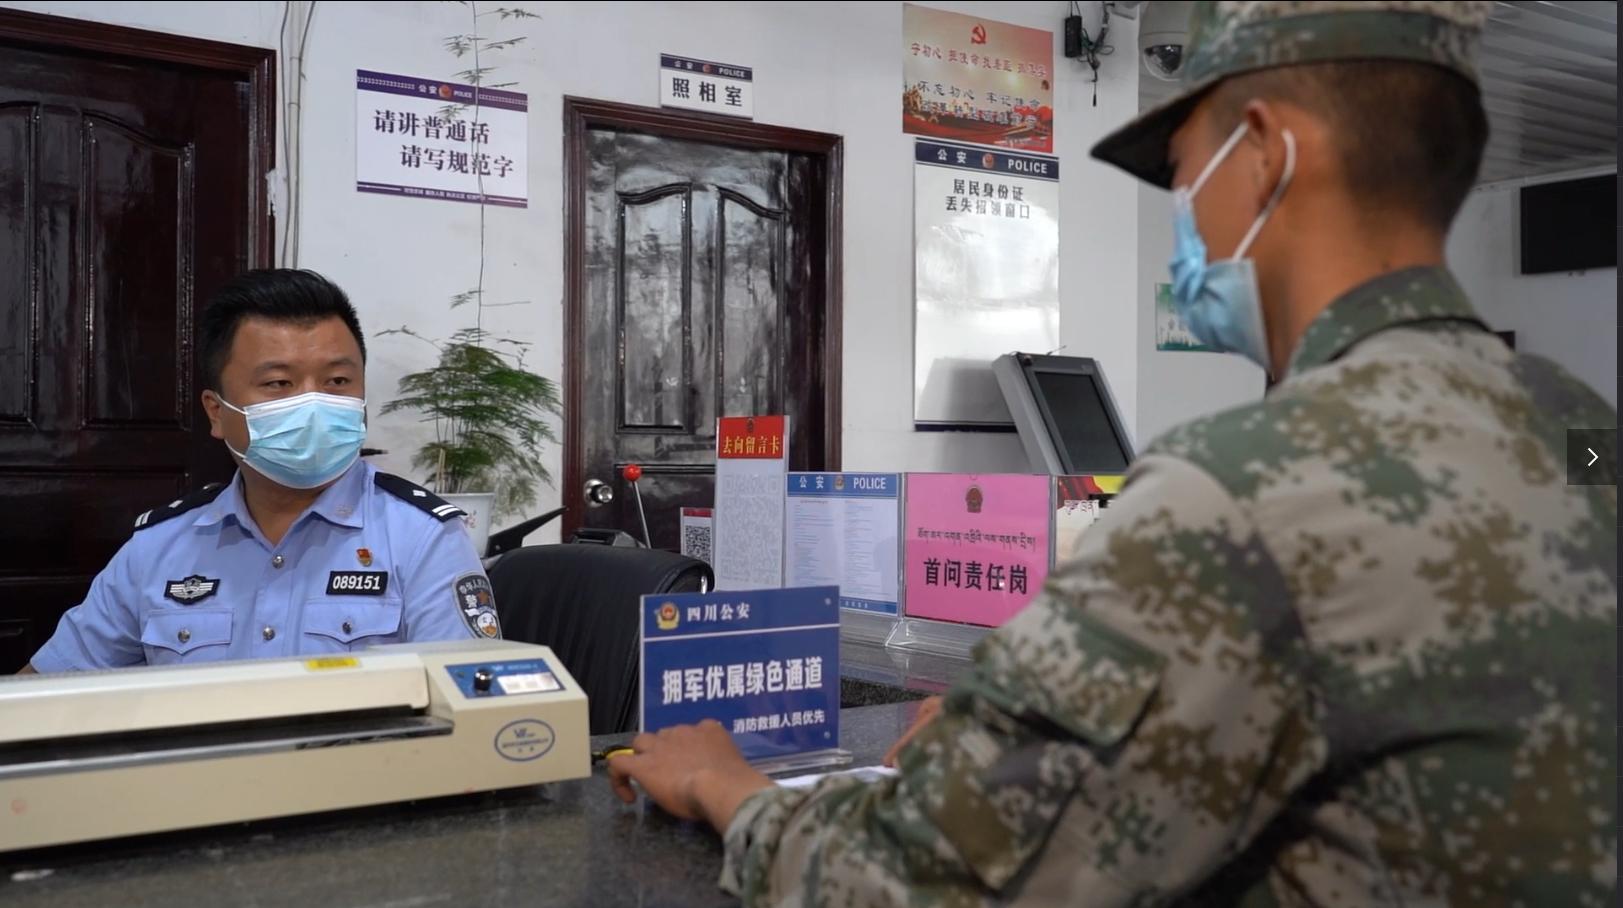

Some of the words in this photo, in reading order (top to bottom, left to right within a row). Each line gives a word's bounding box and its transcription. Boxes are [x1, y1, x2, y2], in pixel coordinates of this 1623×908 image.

[718, 67, 745, 78] POLICE
[418, 84, 437, 94] 公安
[672, 77, 742, 107] 照相室
[374, 109, 490, 144] 请讲普通话
[400, 145, 514, 178] 请写规范字
[937, 149, 967, 164] 公安
[1007, 158, 1048, 174] POLICE
[953, 178, 1024, 201] 居民身份证
[945, 196, 1030, 219] 丢失招领窗口
[723, 435, 780, 454] 去向留言卡
[799, 475, 824, 489] 公安
[853, 477, 887, 490] POLICE
[332, 575, 381, 590] 089151
[923, 558, 1028, 595] 首问责任岗
[687, 602, 750, 622] 四川公安
[662, 656, 823, 705] 拥军优属绿色通道
[733, 709, 825, 733] 消防救援人员优先
